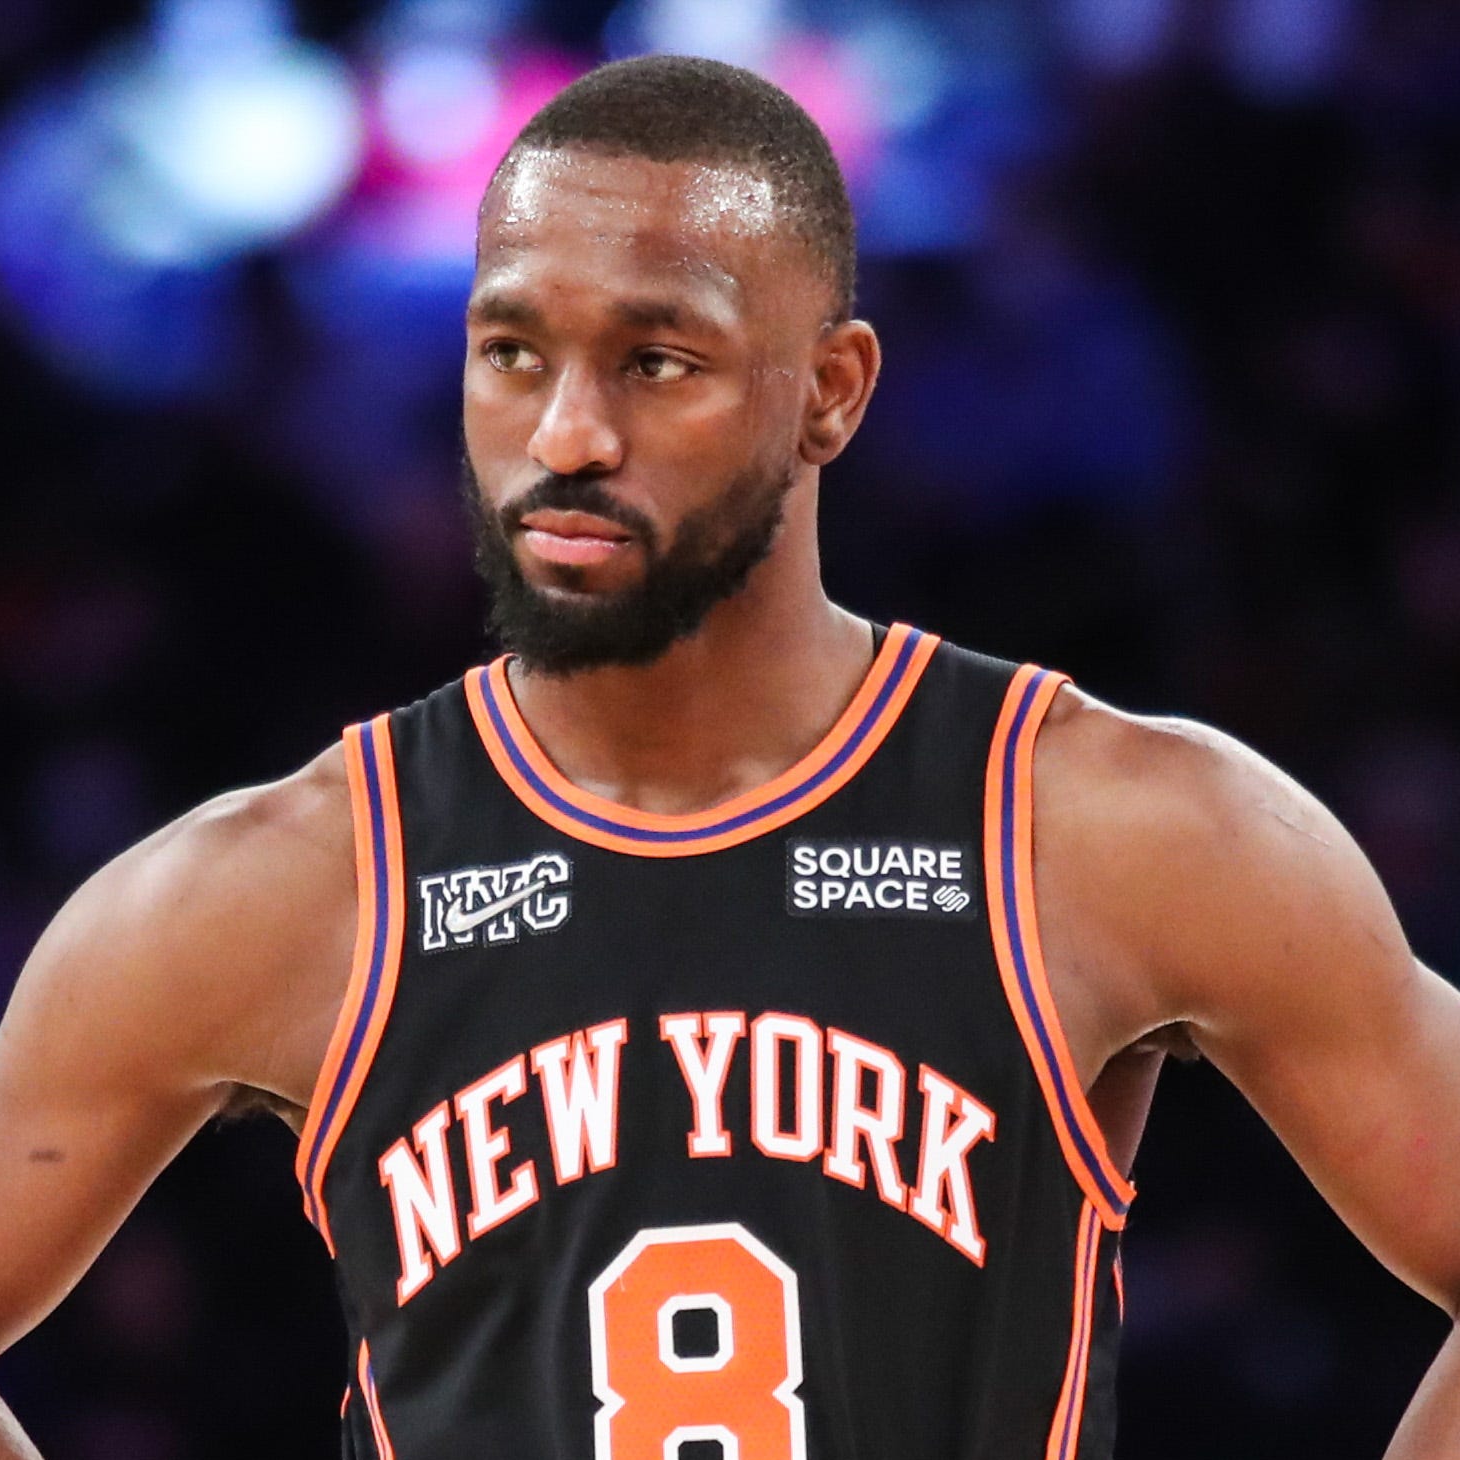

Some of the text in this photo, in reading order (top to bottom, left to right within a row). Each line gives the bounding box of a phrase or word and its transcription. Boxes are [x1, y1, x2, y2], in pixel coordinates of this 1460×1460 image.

[793, 846, 962, 880] SQUARE
[793, 880, 928, 911] SPACE
[420, 854, 569, 950] NYC
[378, 1011, 996, 1308] NEW YORK
